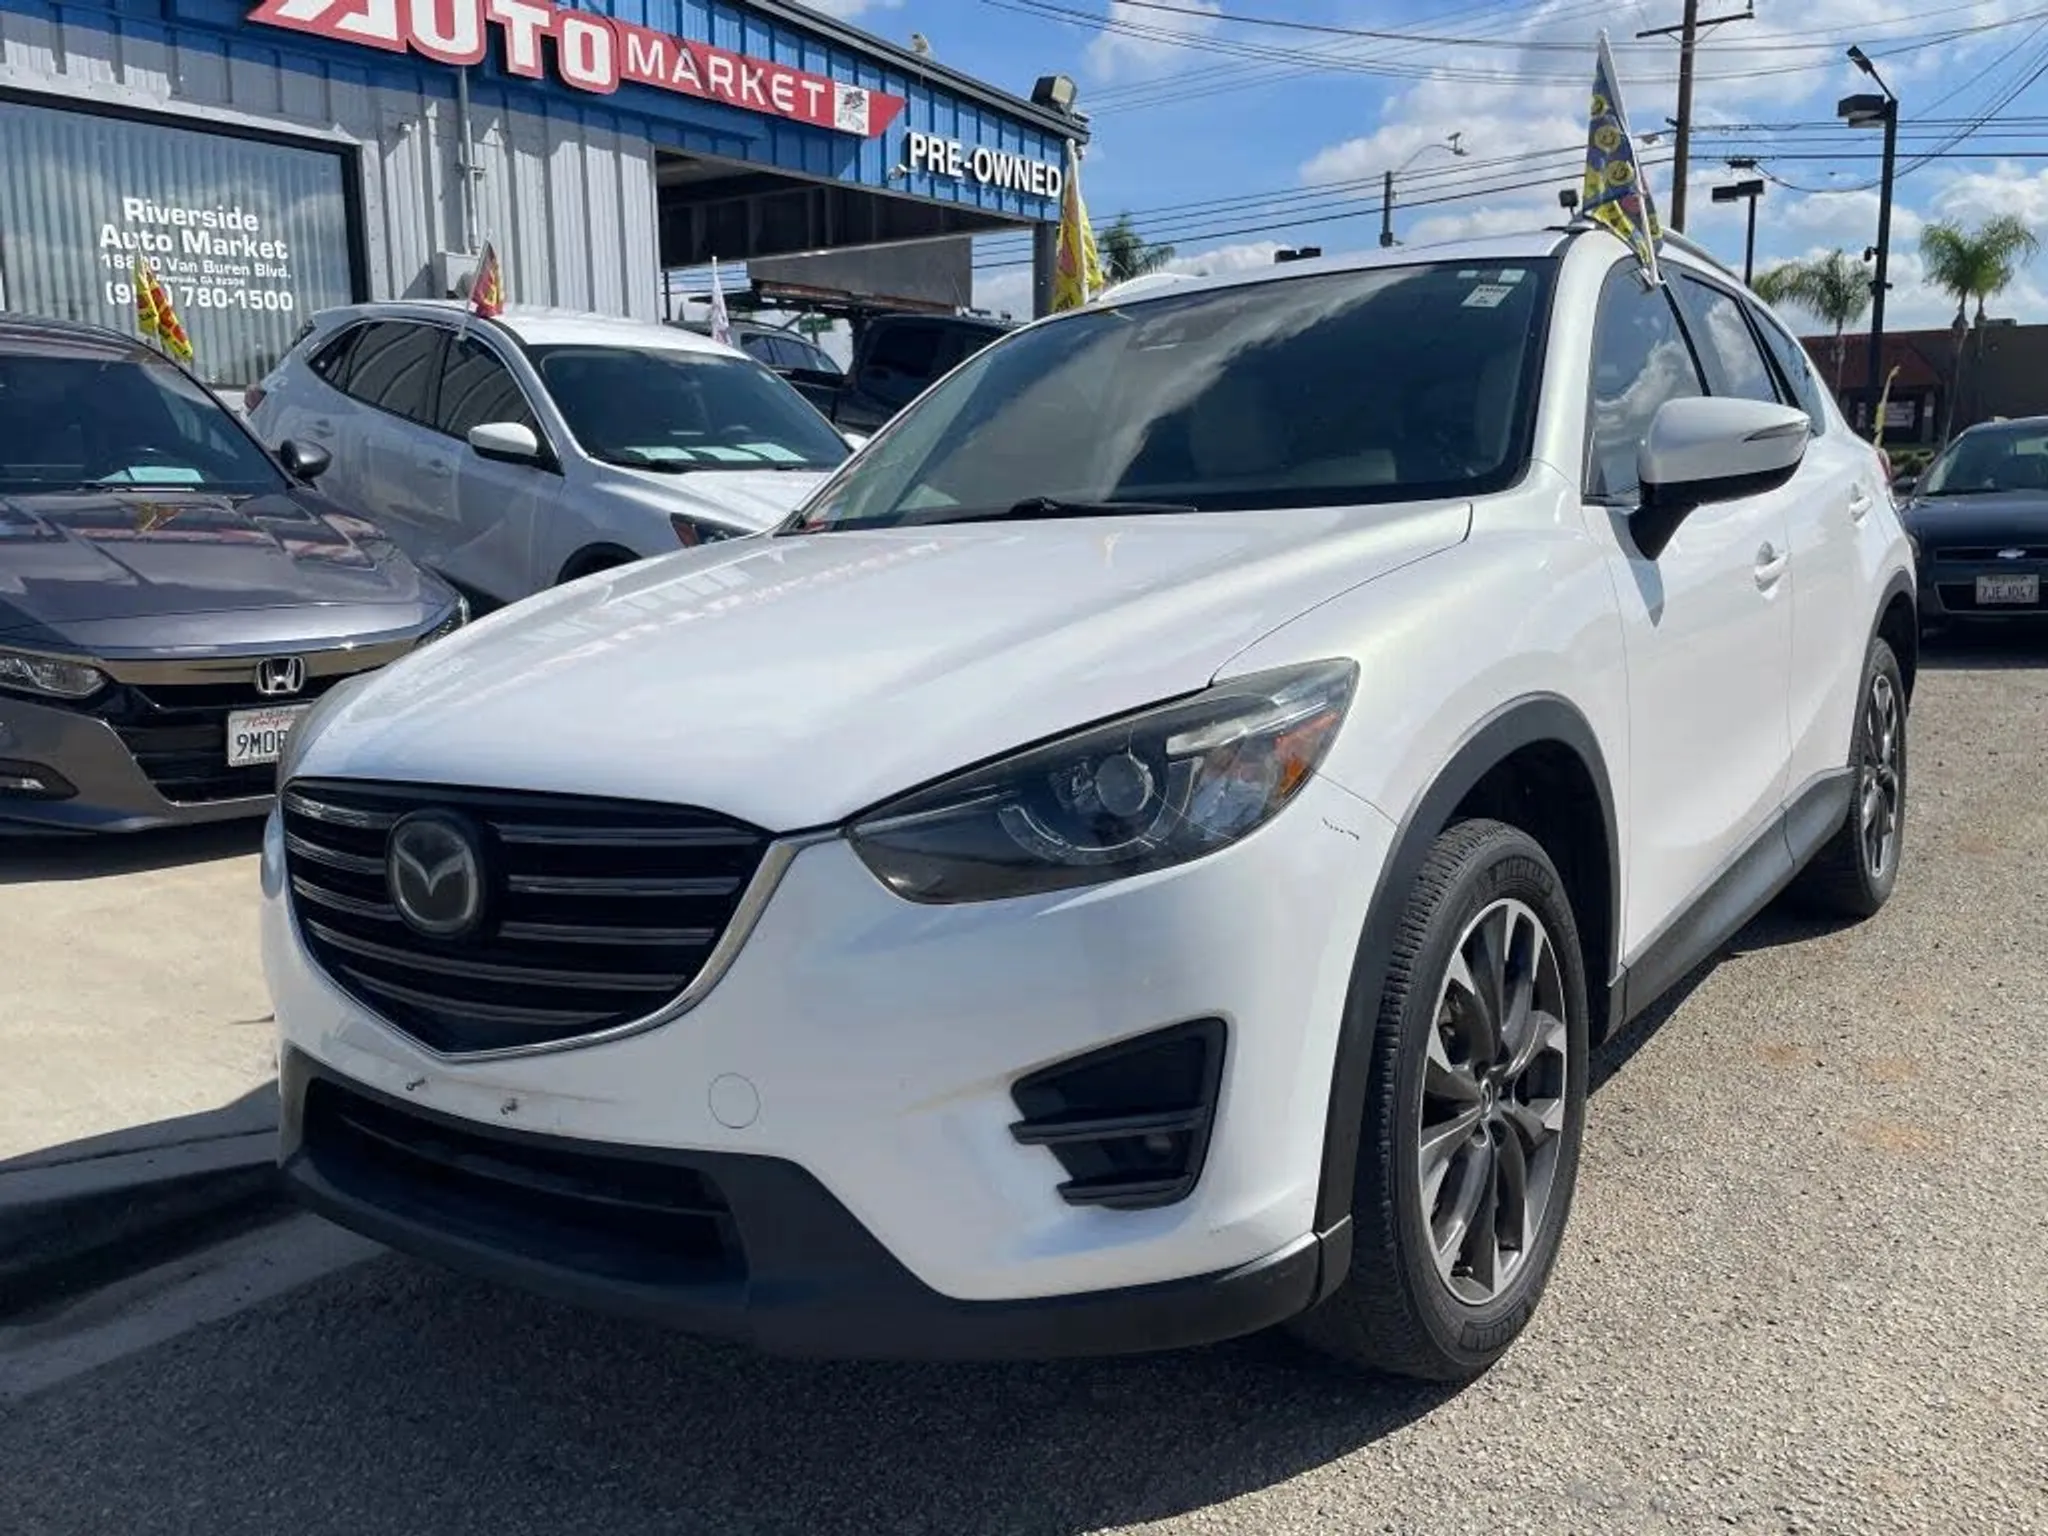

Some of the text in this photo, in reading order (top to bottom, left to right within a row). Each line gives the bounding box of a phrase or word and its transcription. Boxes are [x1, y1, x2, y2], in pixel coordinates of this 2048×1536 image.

[627, 33, 825, 118] MARKET
[909, 131, 1062, 198] PRE-OWNED
[123, 195, 259, 232] Riverside
[100, 223, 289, 260] Auto Market
[166, 257, 199, 274] Van
[203, 259, 250, 276] Buren
[254, 262, 292, 279] Blvd.
[180, 285, 294, 311] 780-1500
